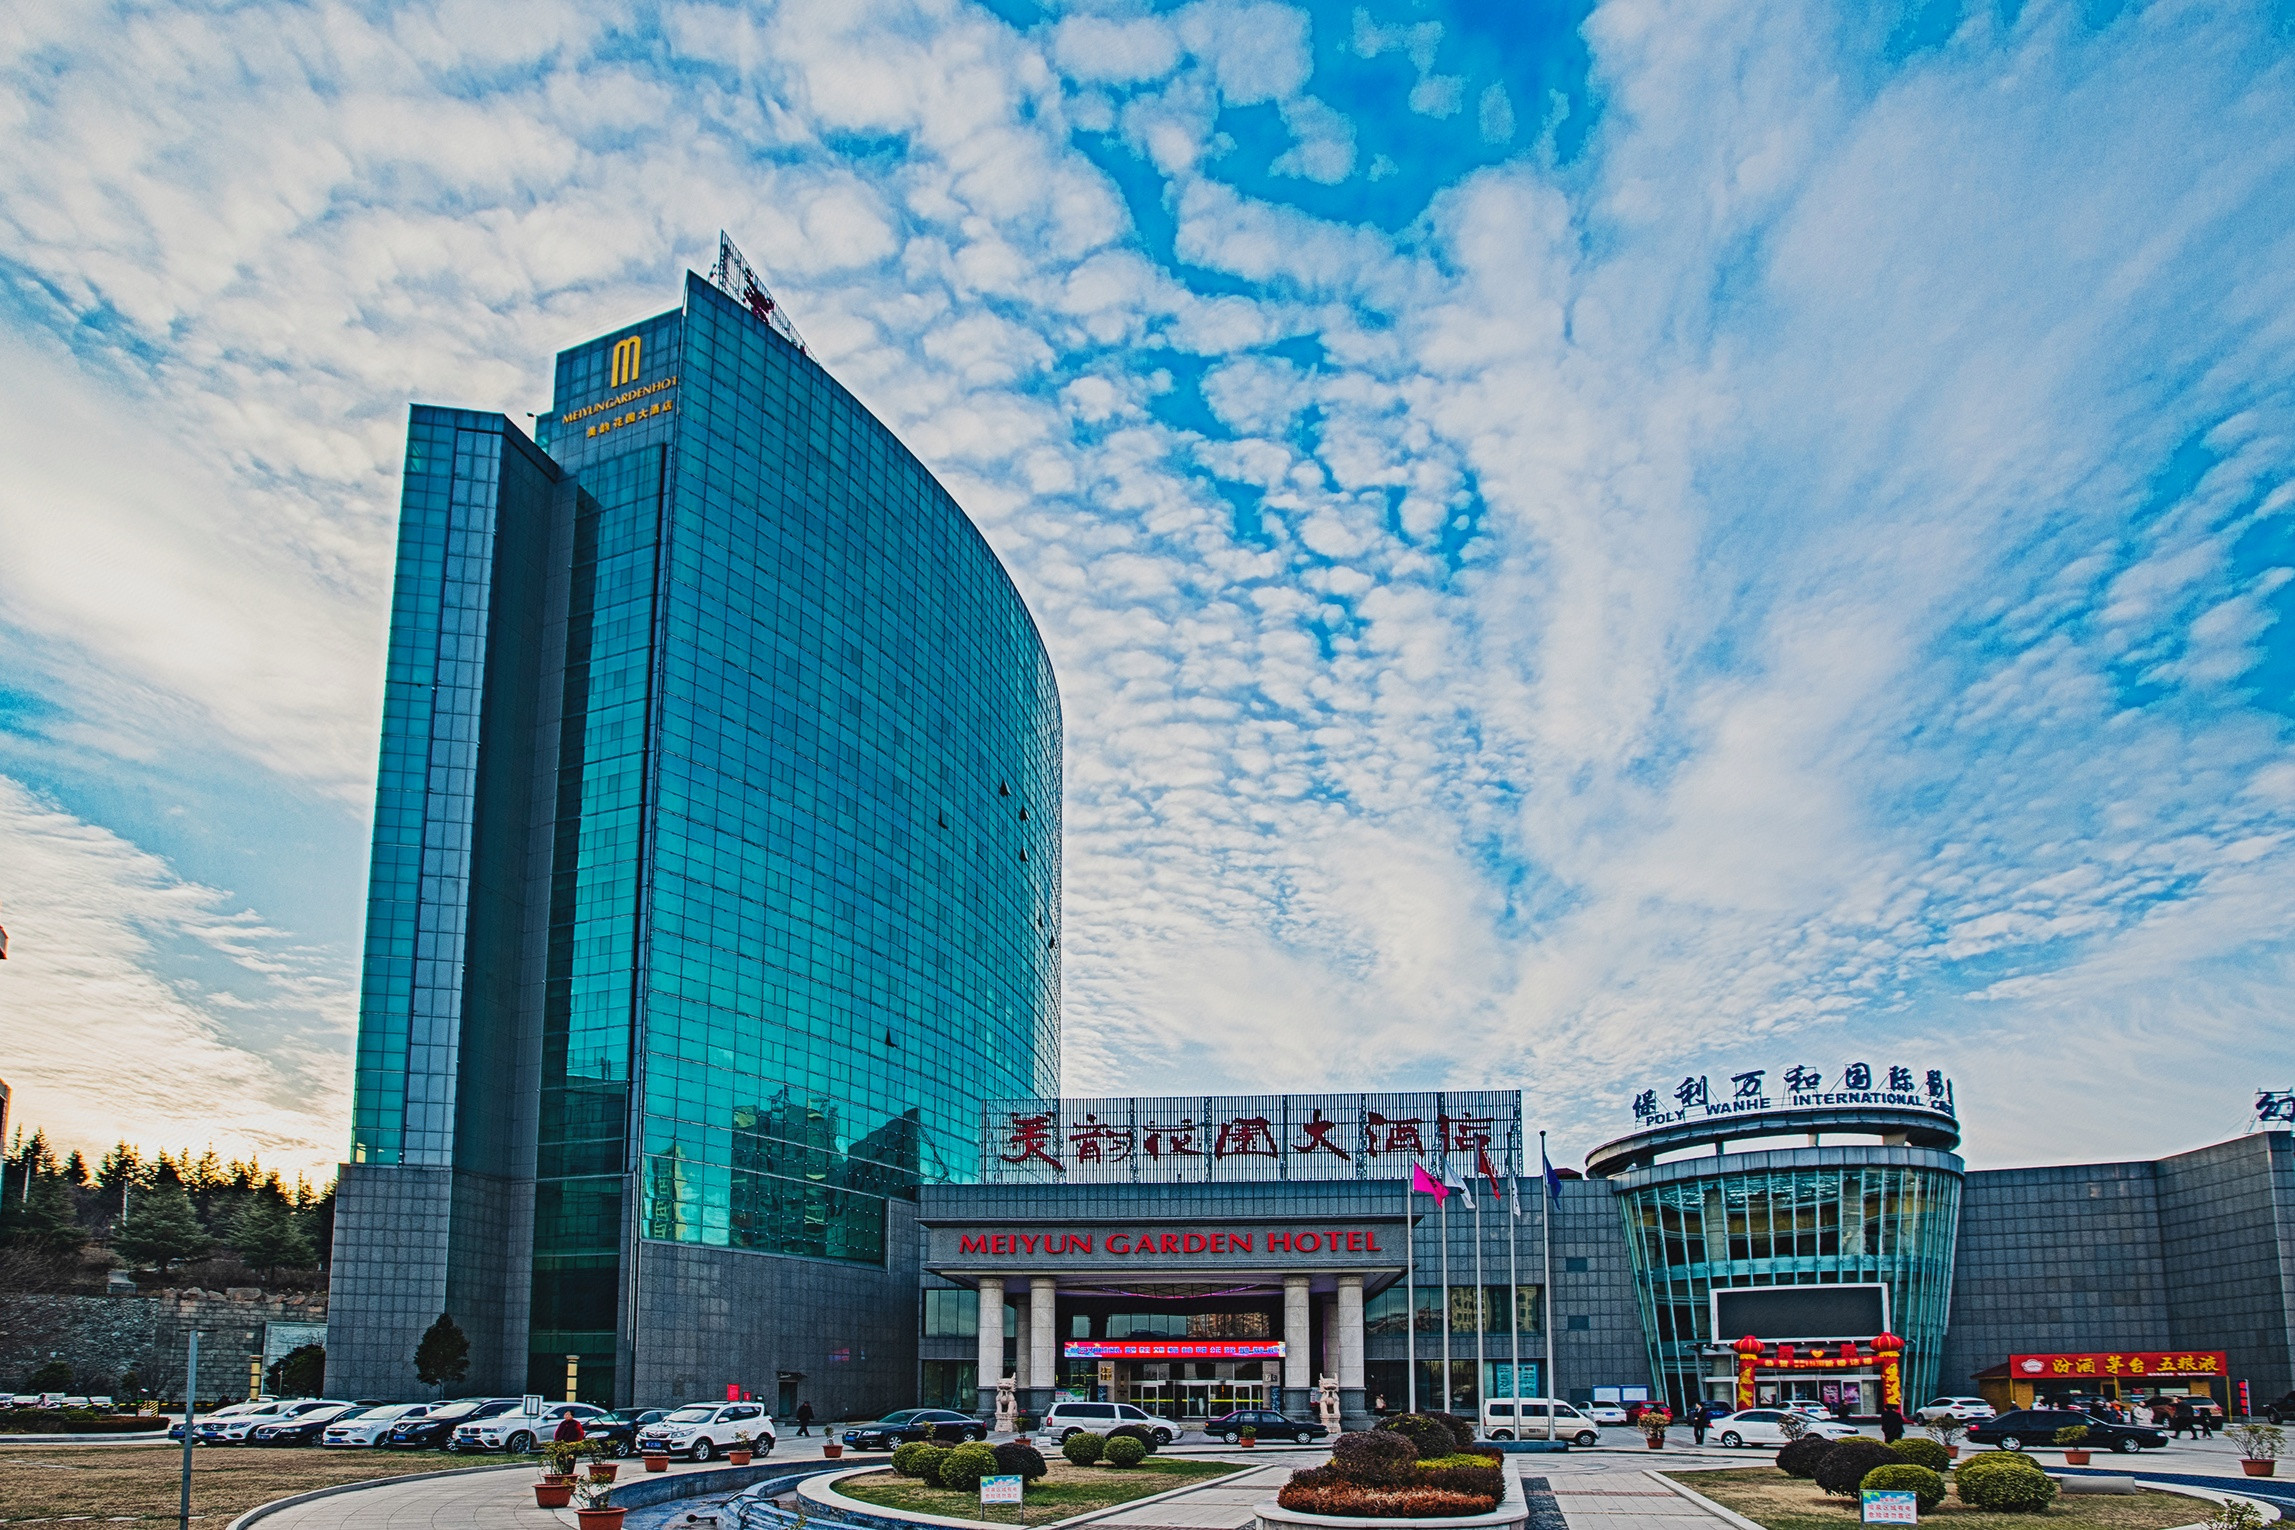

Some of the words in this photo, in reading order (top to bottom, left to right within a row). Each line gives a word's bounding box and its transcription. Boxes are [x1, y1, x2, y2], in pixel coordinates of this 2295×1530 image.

[1646, 1109, 1686, 1127] POLY
[1705, 1097, 1771, 1115] WANHE
[1792, 1091, 1925, 1107] INTERNATIONAL
[958, 1233, 1092, 1255] MEIYUN
[1105, 1232, 1253, 1254] GARDEN
[1267, 1231, 1382, 1252] HOTEL
[2052, 1357, 2096, 1373] 汾酒
[2105, 1355, 2145, 1374] 茅台
[2157, 1355, 2220, 1372] 五粮液
